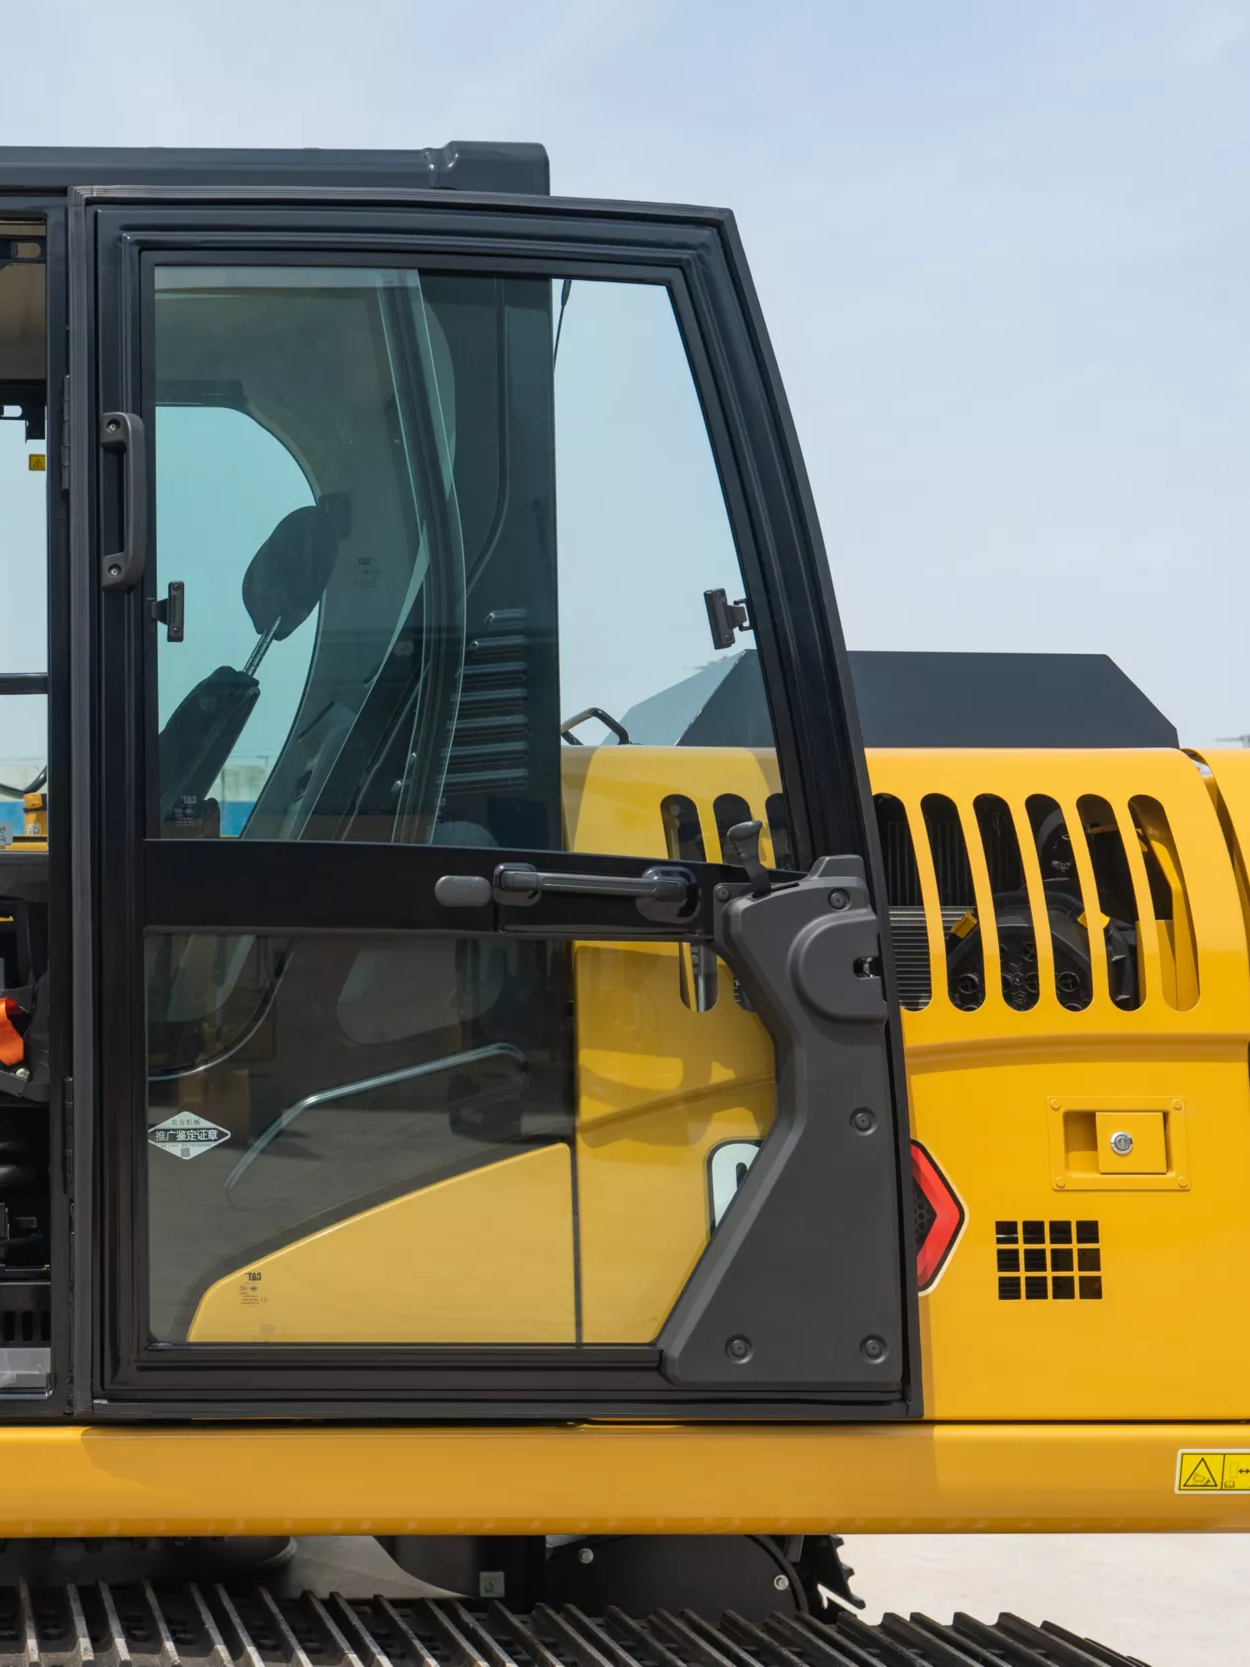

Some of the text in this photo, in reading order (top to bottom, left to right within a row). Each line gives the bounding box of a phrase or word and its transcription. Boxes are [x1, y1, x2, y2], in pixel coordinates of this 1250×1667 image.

[155, 1129, 218, 1142] 推广鉴定证章
